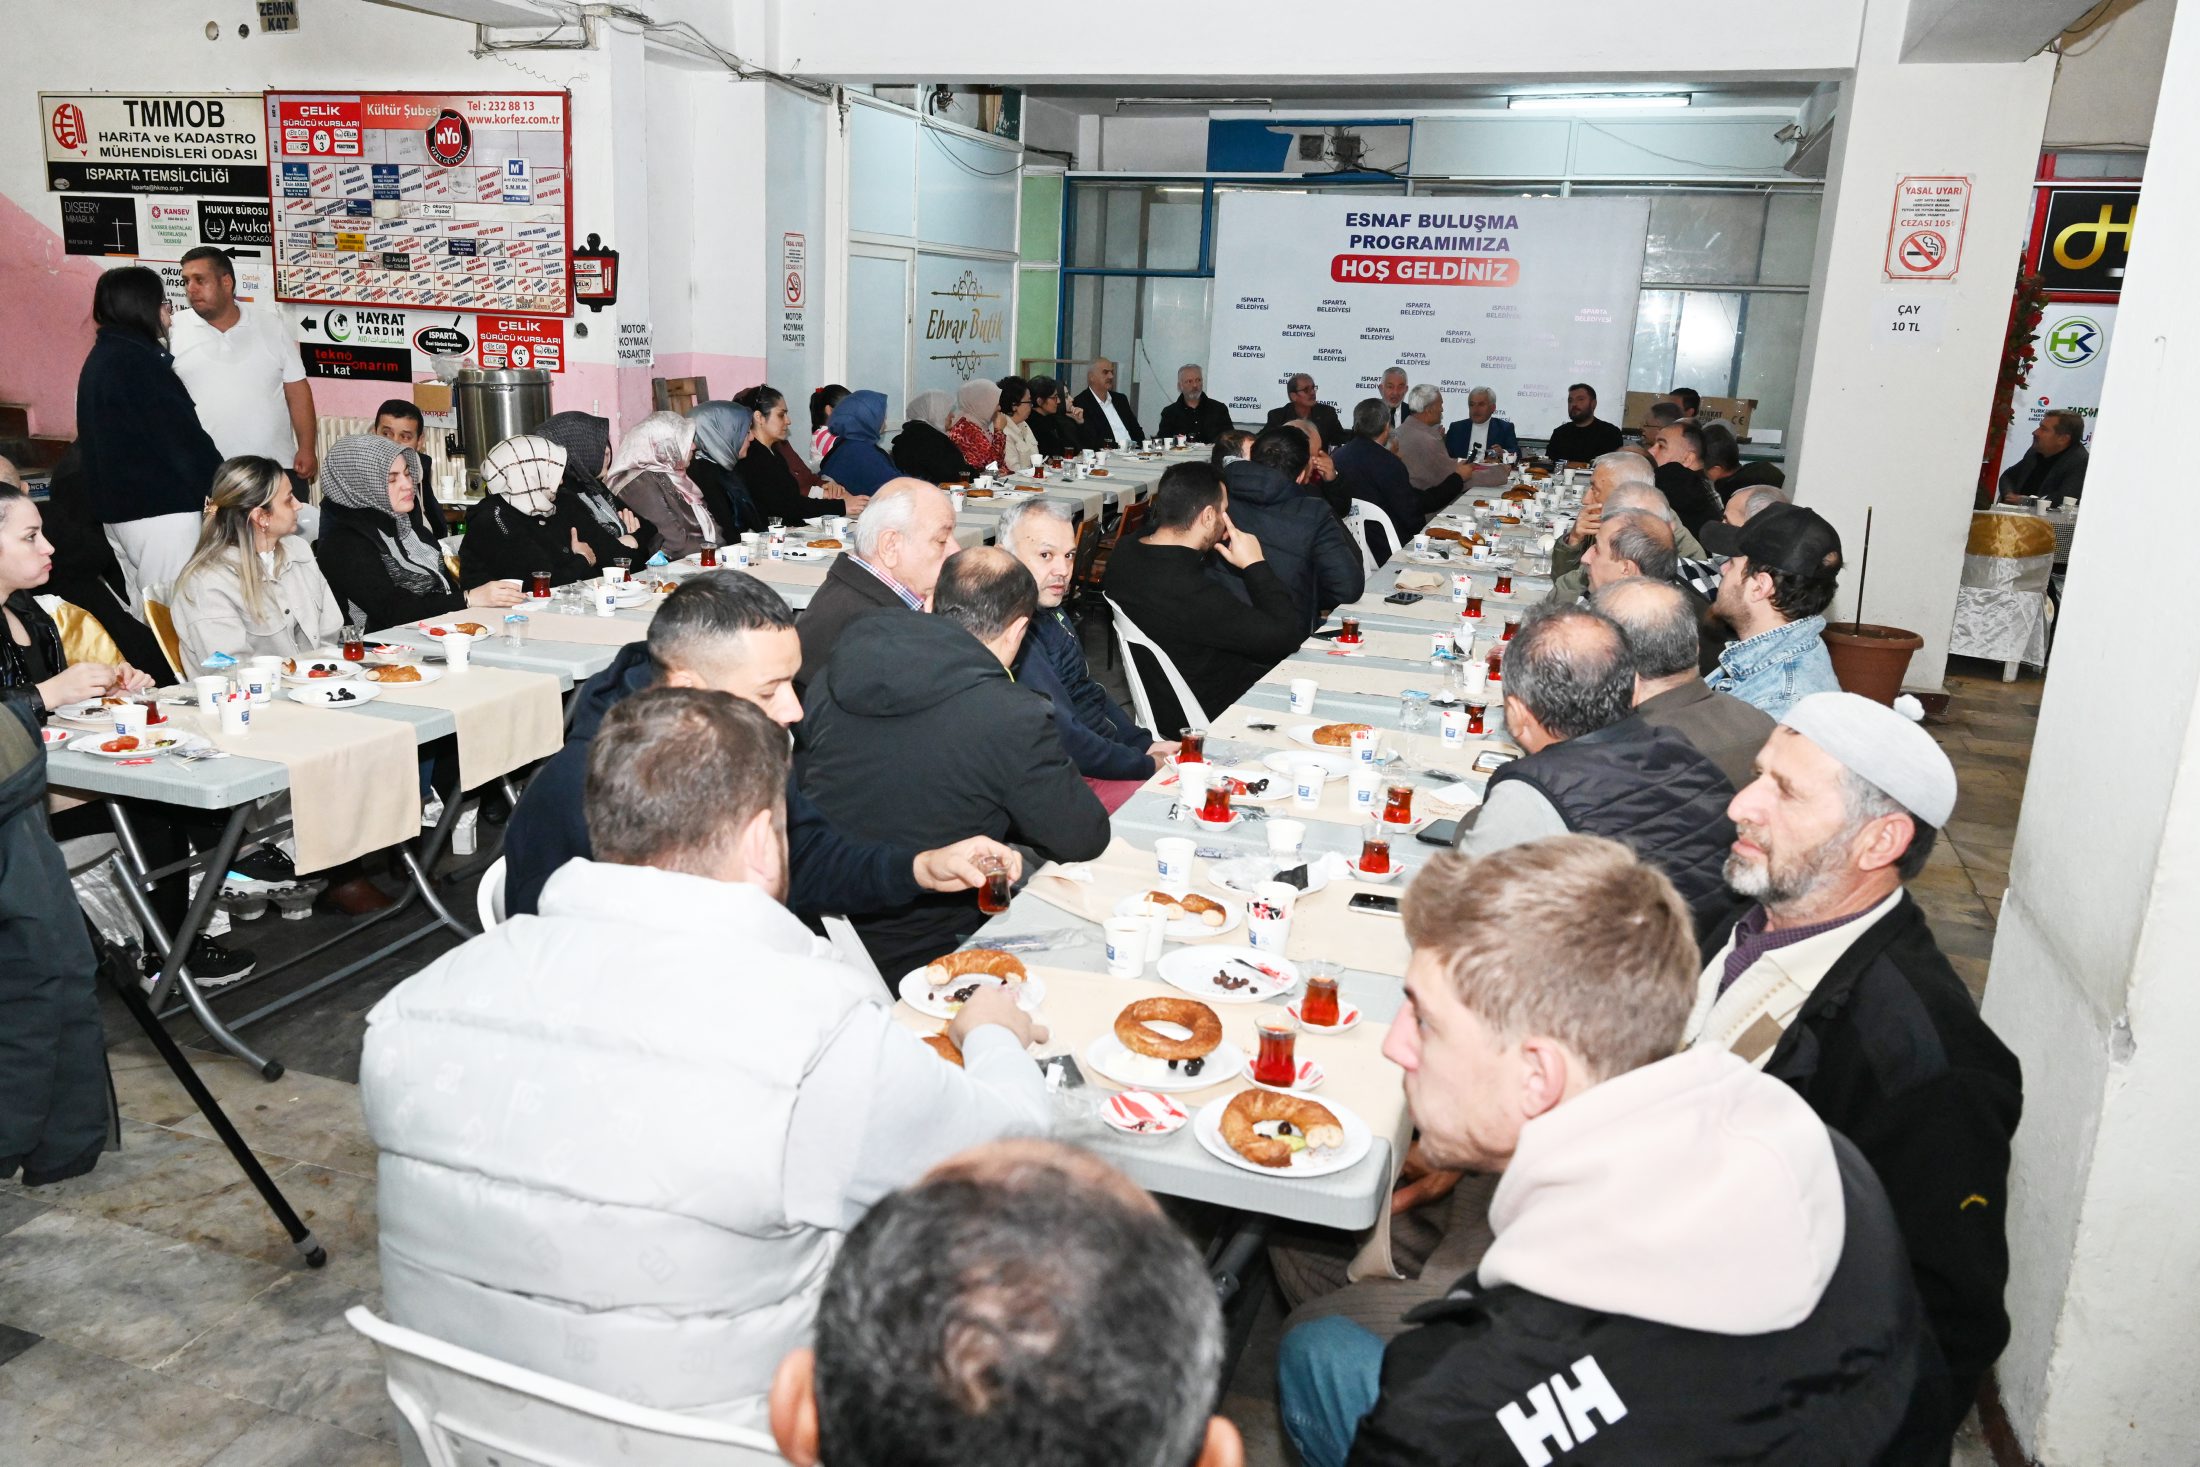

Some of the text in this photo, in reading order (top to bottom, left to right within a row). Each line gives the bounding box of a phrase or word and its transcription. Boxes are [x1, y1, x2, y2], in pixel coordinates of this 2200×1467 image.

[260, 2, 294, 16] ZEMİN
[268, 18, 289, 31] KAT
[300, 104, 341, 118] ÇELİK
[367, 103, 440, 119] Kültür Şubesi
[467, 101, 481, 111] Tel
[488, 101, 506, 111] 232
[508, 101, 520, 111] 88
[524, 101, 535, 111] 13
[123, 100, 225, 128] TMMOB
[467, 114, 560, 125] www.korfez.com.tr
[283, 119, 360, 128] SÜRÜCÜ KURSLARI
[154, 135, 170, 143] ve
[174, 133, 256, 144] KADASTRO
[437, 127, 460, 144] MYD
[319, 142, 325, 151] 3
[100, 145, 258, 160] MÜHENDİSLERİ ODASI
[86, 167, 230, 184] ISPARTA TEMSİLCİLİĞİ
[1905, 187, 1963, 195] YASAL UYARI
[205, 205, 269, 216] HUKUK BÜROSU
[1345, 212, 1519, 232] ESNAF BULUŞMA
[1900, 219, 1933, 227] CEZASI
[1350, 234, 1510, 252] PROGRAMIMIZA
[1341, 258, 1509, 282] HOŞ GELDİNİZ
[1236, 303, 1269, 311] BELEDİYESİ
[1898, 305, 1921, 315] ÇAY
[356, 312, 406, 326] HAYRAT
[357, 326, 405, 337] YARDIM
[498, 320, 542, 332] ÇELİK
[621, 325, 646, 333] MOTOR
[926, 309, 968, 344] Ebrar
[1891, 322, 1921, 332] 10 TL
[429, 331, 458, 340] ISPARTA
[480, 333, 561, 344] SÜRÜCÜ KURSLARI
[782, 334, 806, 342] YASAKTIR
[619, 337, 649, 346] KOYMAK
[315, 349, 353, 361] tekno
[617, 349, 651, 359] YASAKTIR
[518, 356, 524, 365] 3
[318, 364, 350, 375] 1. kat
[352, 362, 398, 372] onarım
